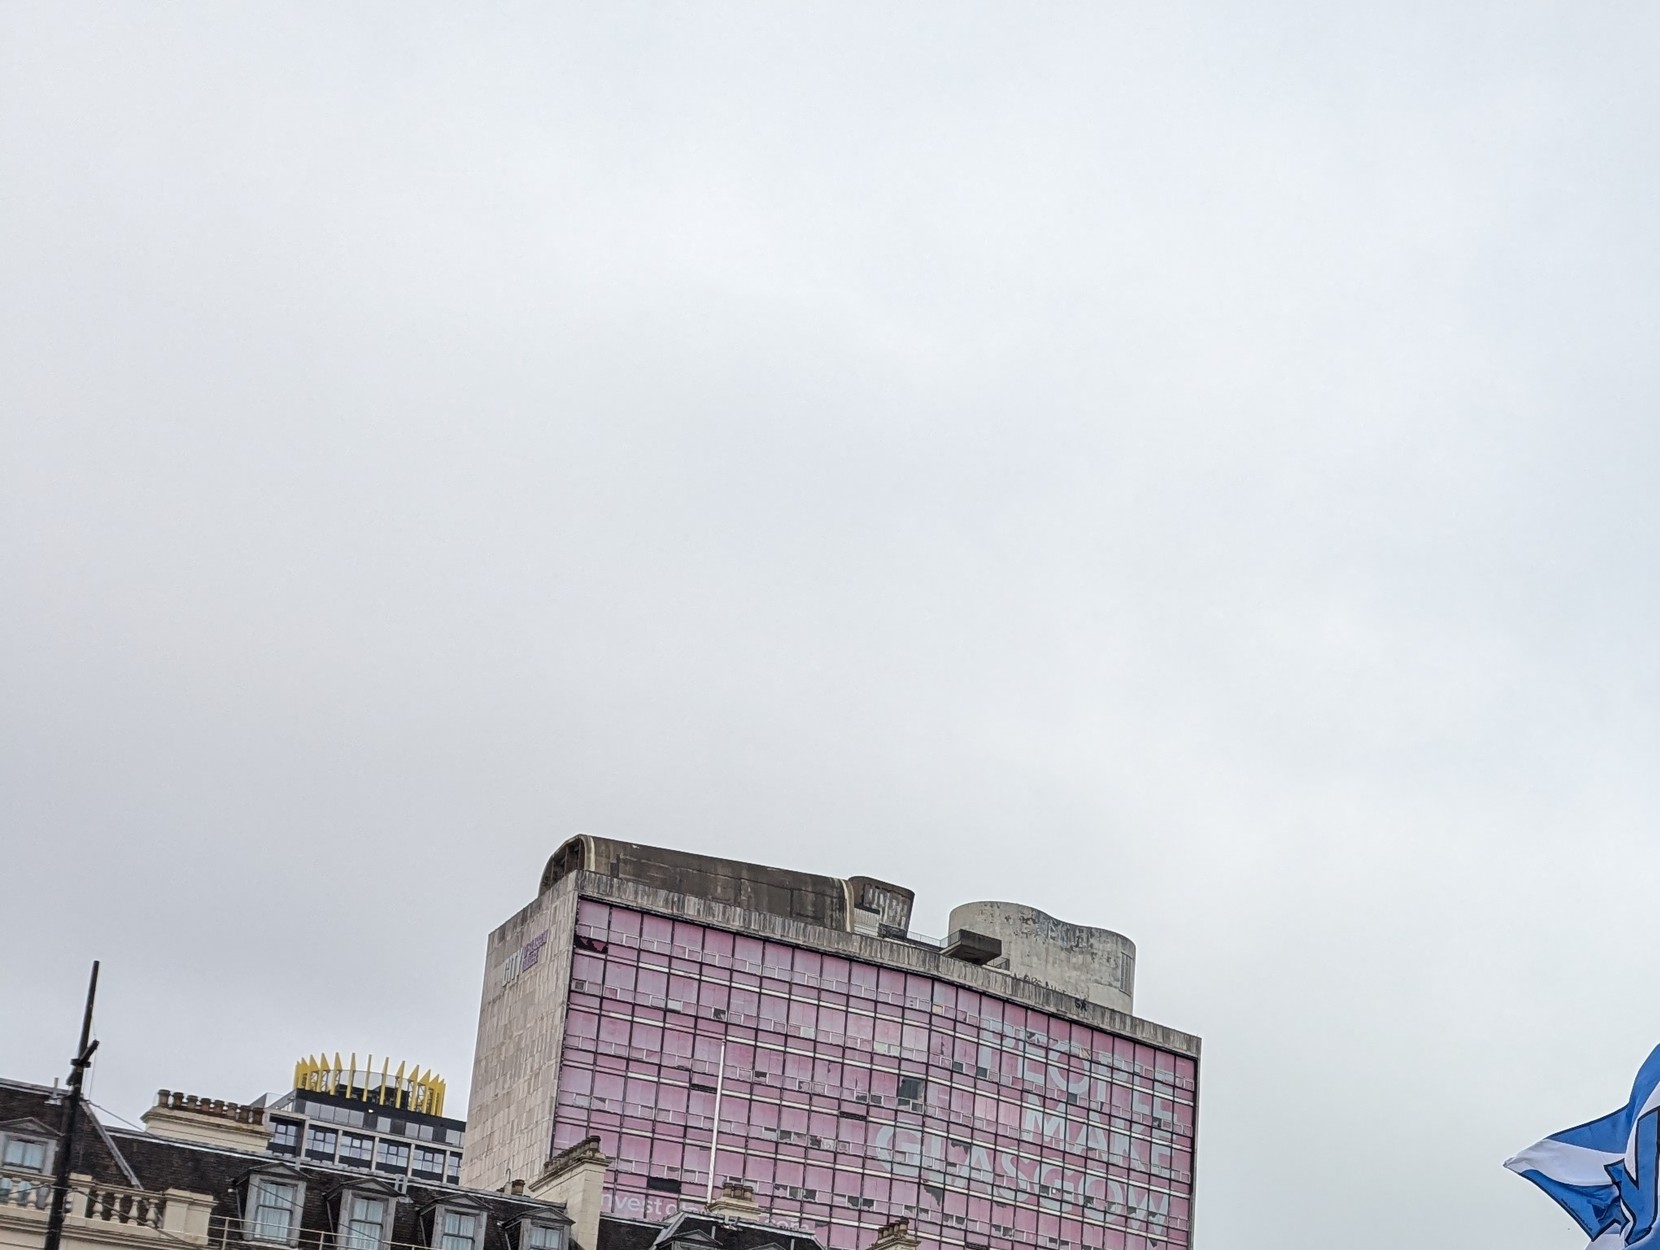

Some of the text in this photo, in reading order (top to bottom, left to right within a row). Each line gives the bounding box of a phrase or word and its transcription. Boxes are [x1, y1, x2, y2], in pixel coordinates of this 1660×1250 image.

[977, 1018, 1180, 1131] PEOPLE
[875, 1120, 1172, 1234] GLASGOW
[1024, 1092, 1176, 1177] MAKE
